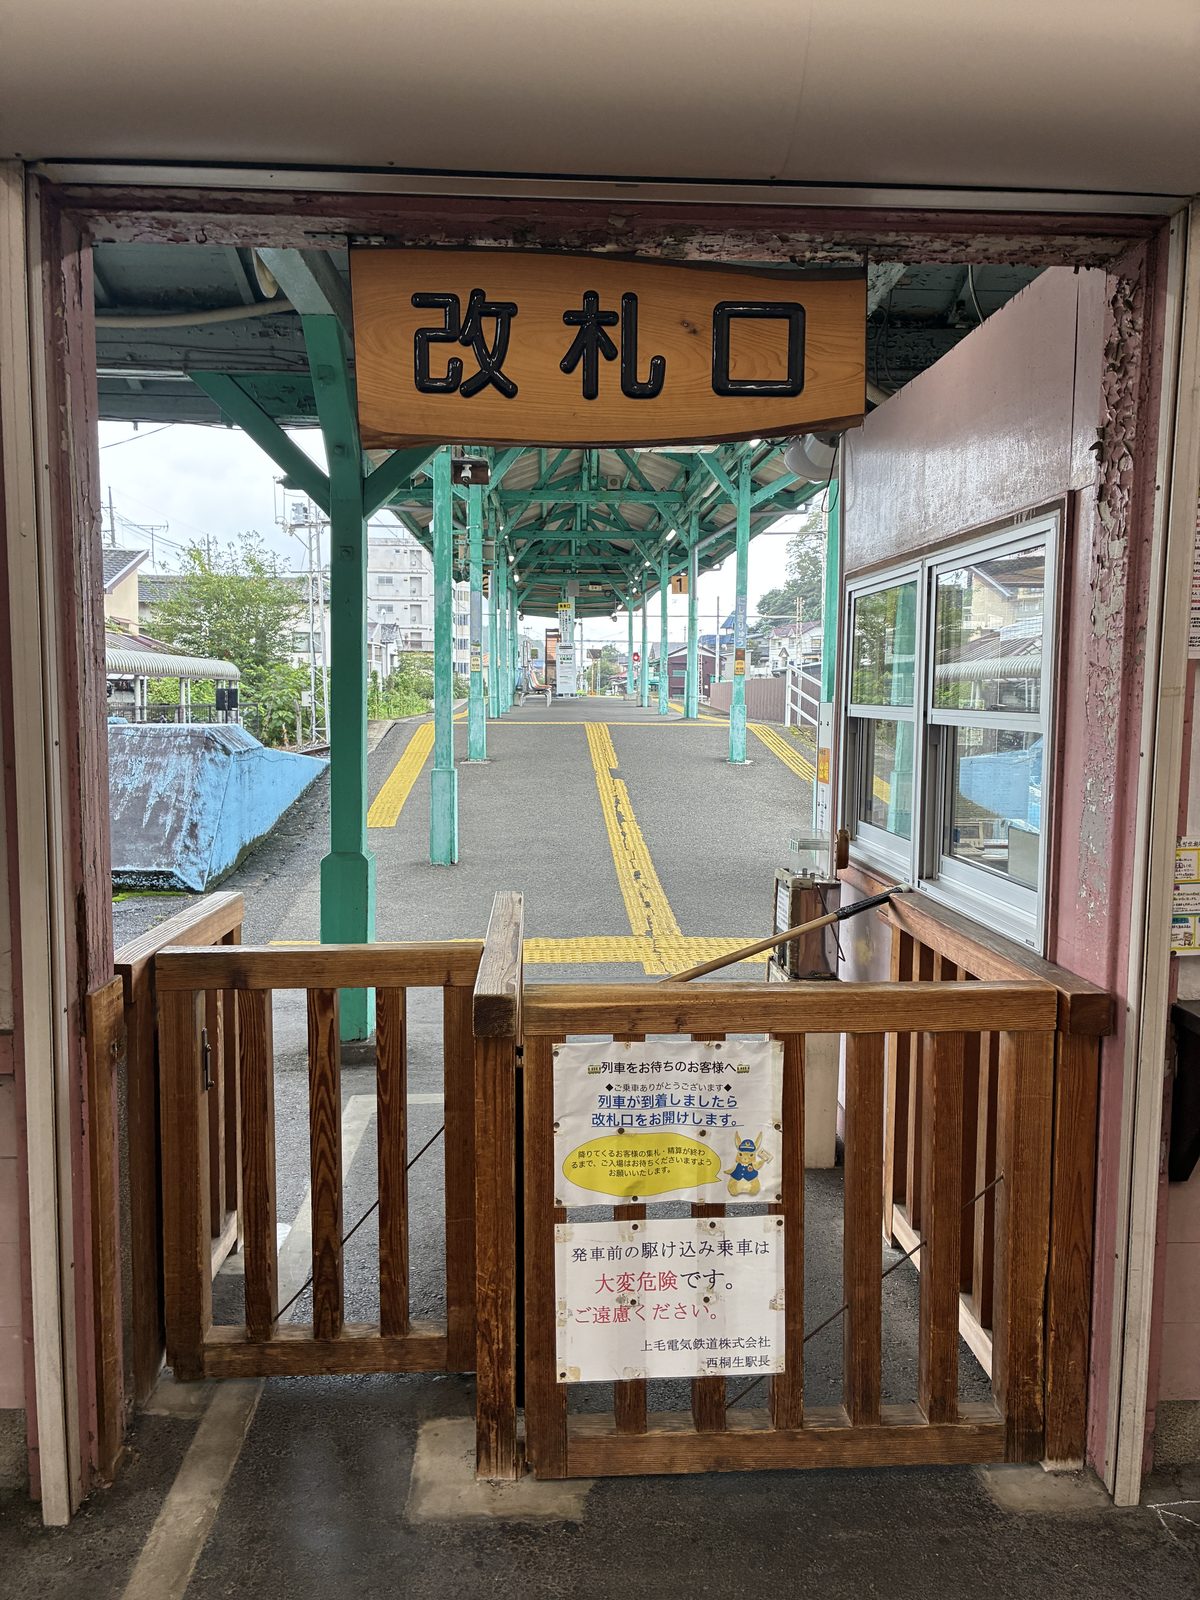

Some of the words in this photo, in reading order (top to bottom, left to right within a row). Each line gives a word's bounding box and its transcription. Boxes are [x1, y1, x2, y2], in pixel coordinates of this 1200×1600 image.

[411, 288, 806, 400] 改札口
[676, 577, 683, 593] 1
[601, 1061, 737, 1074] 列車をお待ちのお客様へ
[614, 1083, 724, 1092] ご乗車ありがとうございます
[598, 1093, 738, 1109] 列車が到着しましたら
[591, 1111, 738, 1127] 改札口をお開けします。
[571, 1157, 712, 1169] るまで、ご入場はお待ちくださいますよう
[608, 1166, 671, 1178] お願いいたします。
[572, 1238, 770, 1263] 発車前の駆け込み乗車は
[595, 1269, 734, 1294] 大変危険です。
[575, 1303, 718, 1324] ご遠慮ください。
[641, 1336, 771, 1352] 上毛電気鉄道株式会社
[706, 1354, 770, 1369] 西桐生駅長
